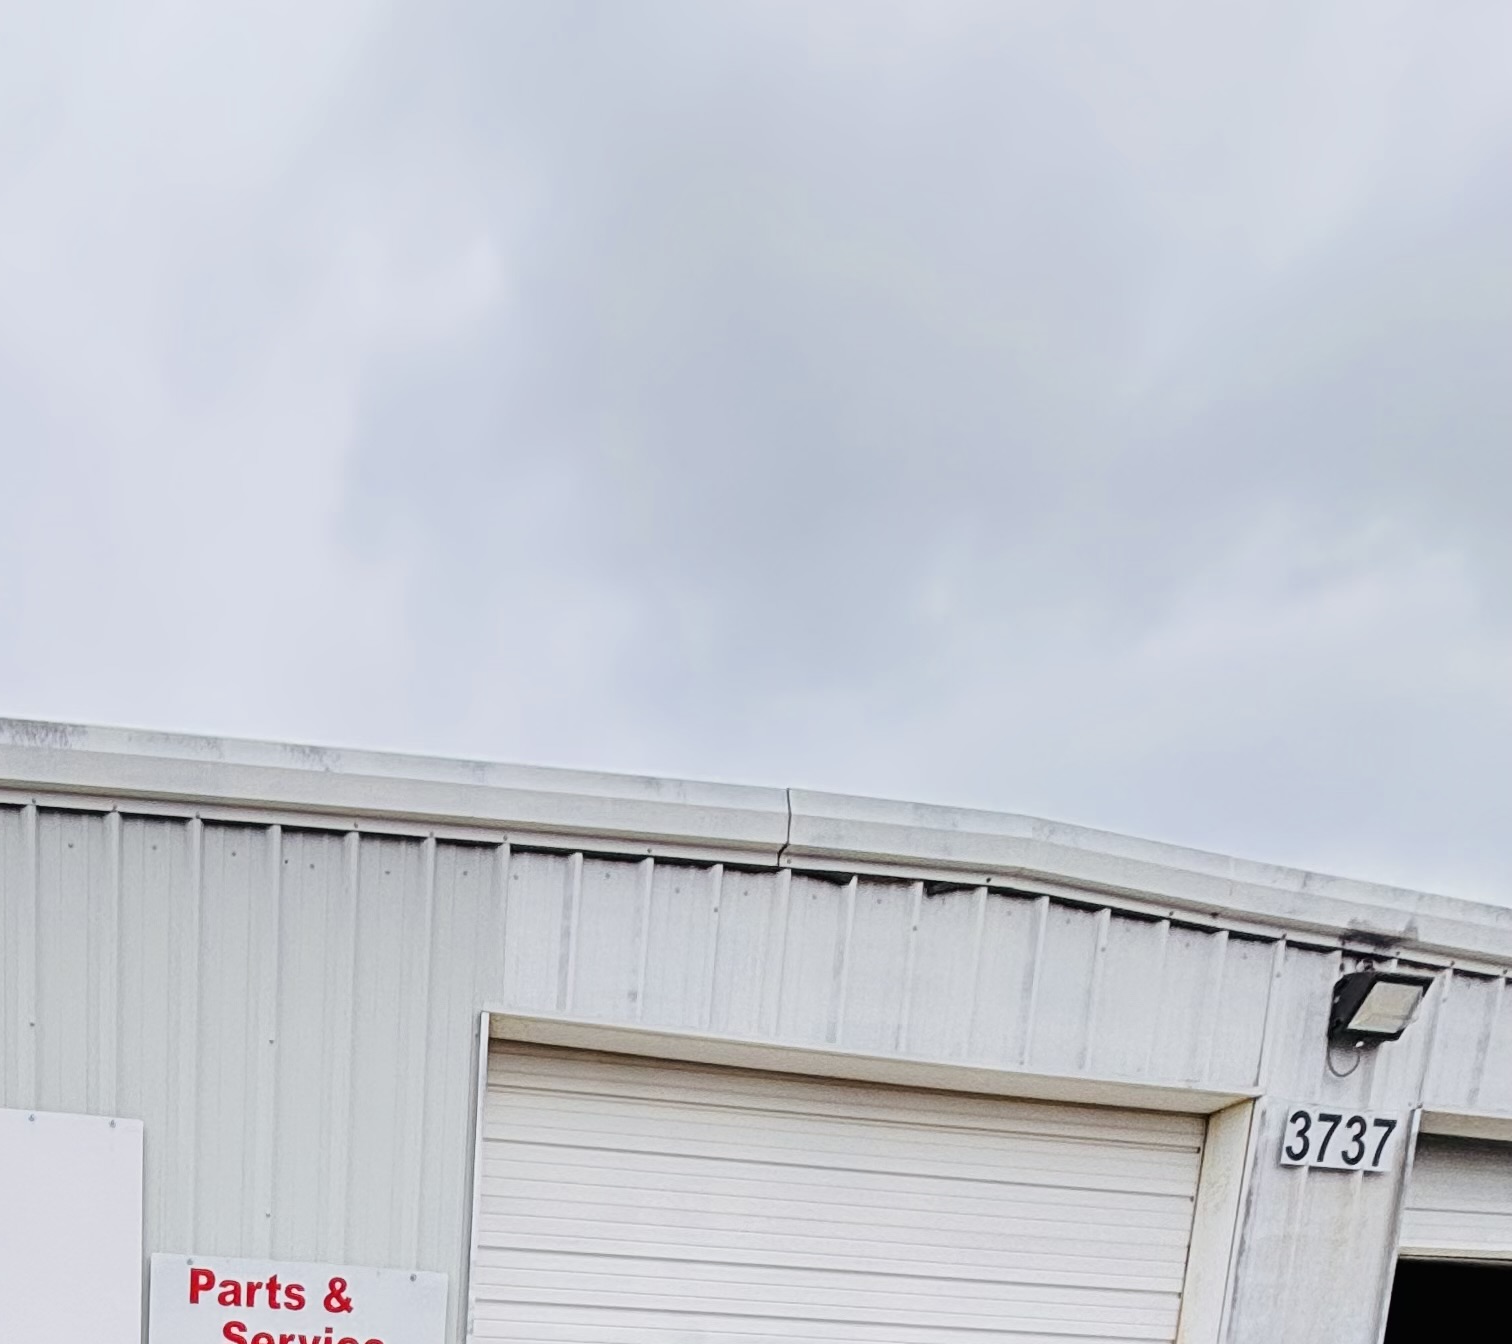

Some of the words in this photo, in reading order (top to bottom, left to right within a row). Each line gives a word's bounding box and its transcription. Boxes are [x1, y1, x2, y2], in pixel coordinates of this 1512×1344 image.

[1285, 1109, 1398, 1167] 3737
[189, 1267, 306, 1311] Parts
[323, 1276, 354, 1314] &
